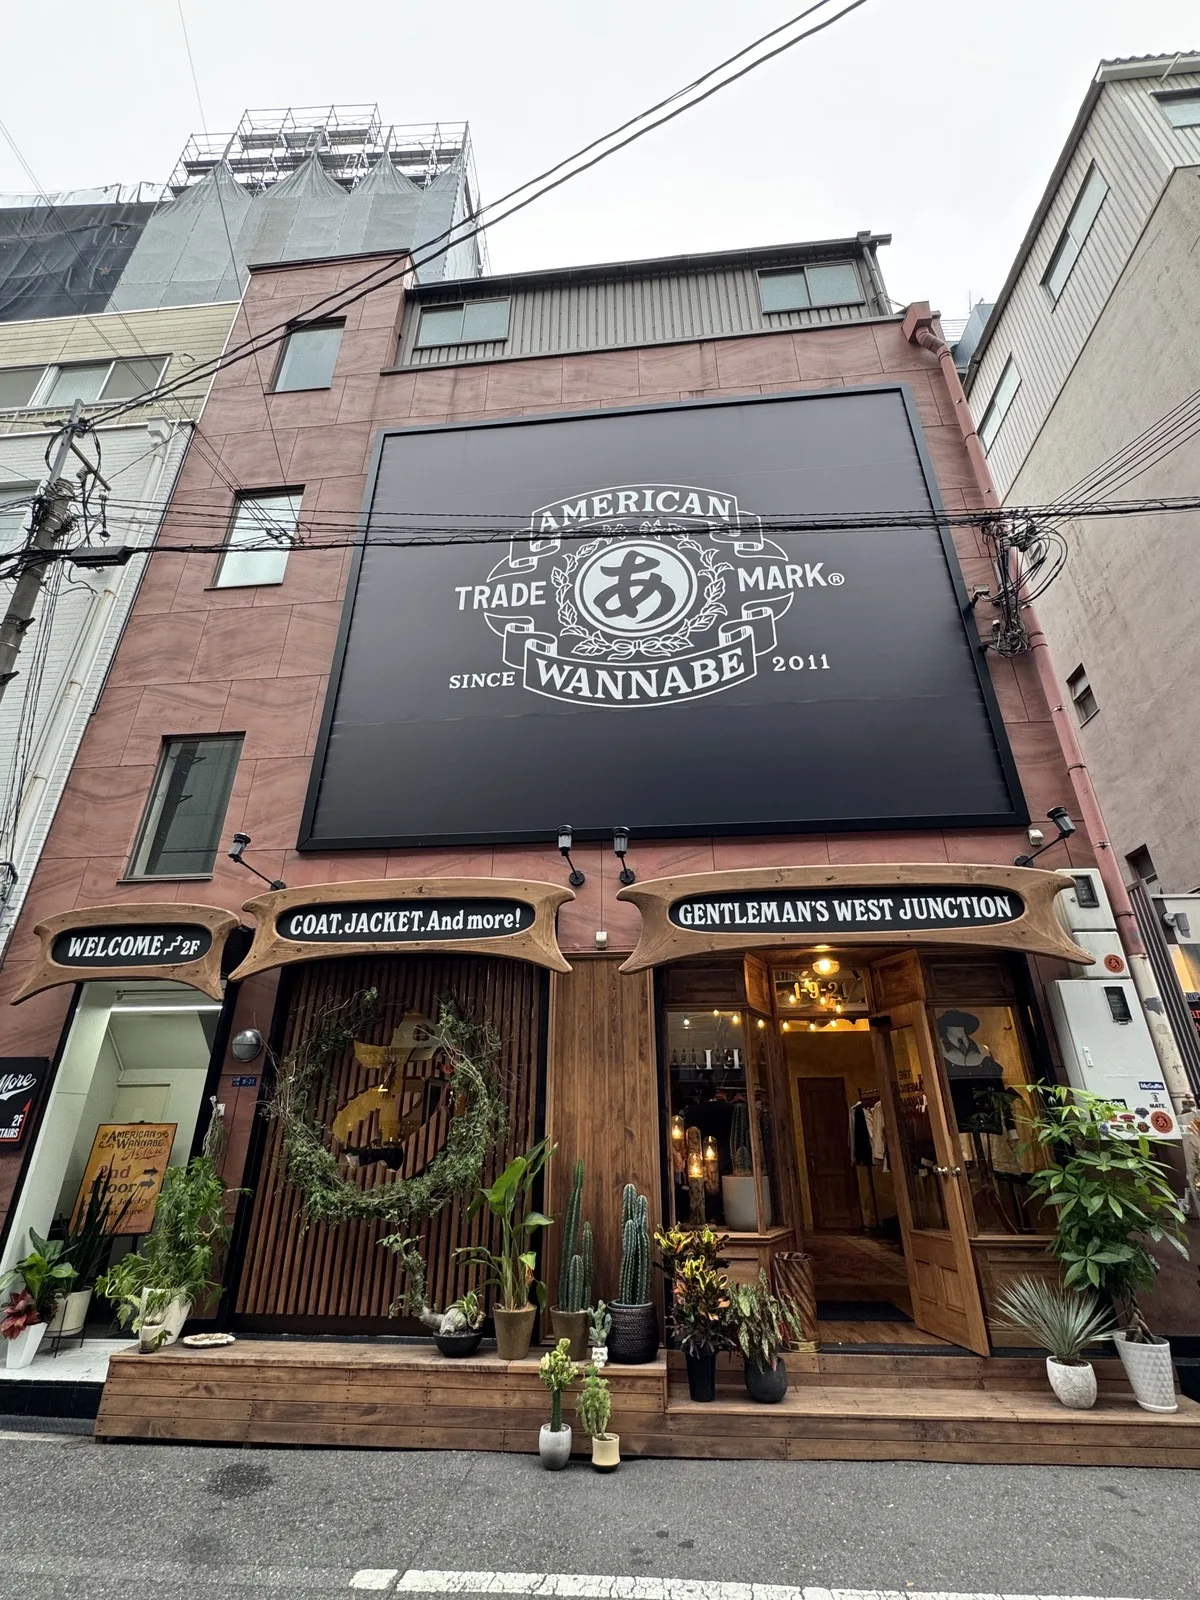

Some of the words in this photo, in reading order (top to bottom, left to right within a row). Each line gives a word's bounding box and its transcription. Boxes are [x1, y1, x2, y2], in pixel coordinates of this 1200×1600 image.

[540, 490, 732, 533] AMERICAN
[455, 581, 547, 610] TRADE
[592, 549, 677, 624] あ
[449, 671, 516, 689] SINCE
[772, 653, 831, 672] 2011
[535, 647, 746, 700] WANNABE
[466, 907, 521, 929] more!
[678, 900, 829, 926] GENTLEMAN'S
[833, 899, 894, 922] WEST
[899, 895, 1013, 920] JUNCTION
[68, 935, 164, 957] WELCOME
[180, 940, 201, 955] 2F
[11, 1114, 24, 1127] 2F
[105, 1130, 157, 1143] AMERICAN
[117, 1139, 164, 1149] WANNABE
[89, 1180, 137, 1194] oor
